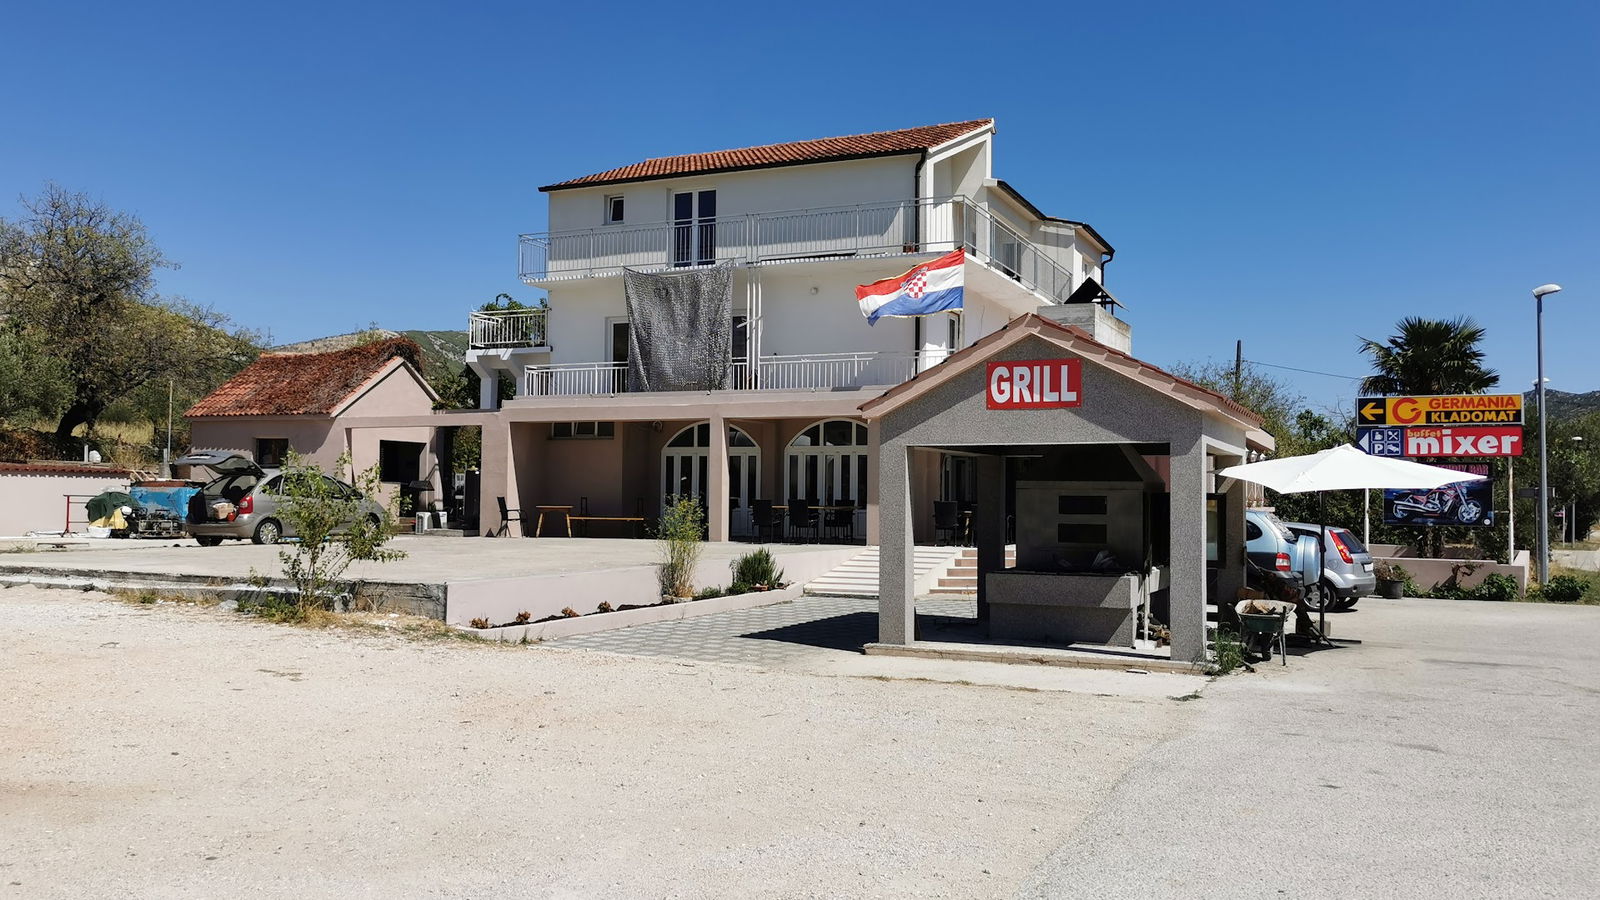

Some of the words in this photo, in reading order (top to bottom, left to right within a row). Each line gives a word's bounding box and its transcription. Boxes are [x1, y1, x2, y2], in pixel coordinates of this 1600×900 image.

[991, 365, 1077, 404] GRILL
[1429, 397, 1516, 410] GERMANIA
[1431, 410, 1516, 423] KLADOMAT
[1407, 429, 1442, 437] buffet
[1408, 429, 1519, 455] mixer
